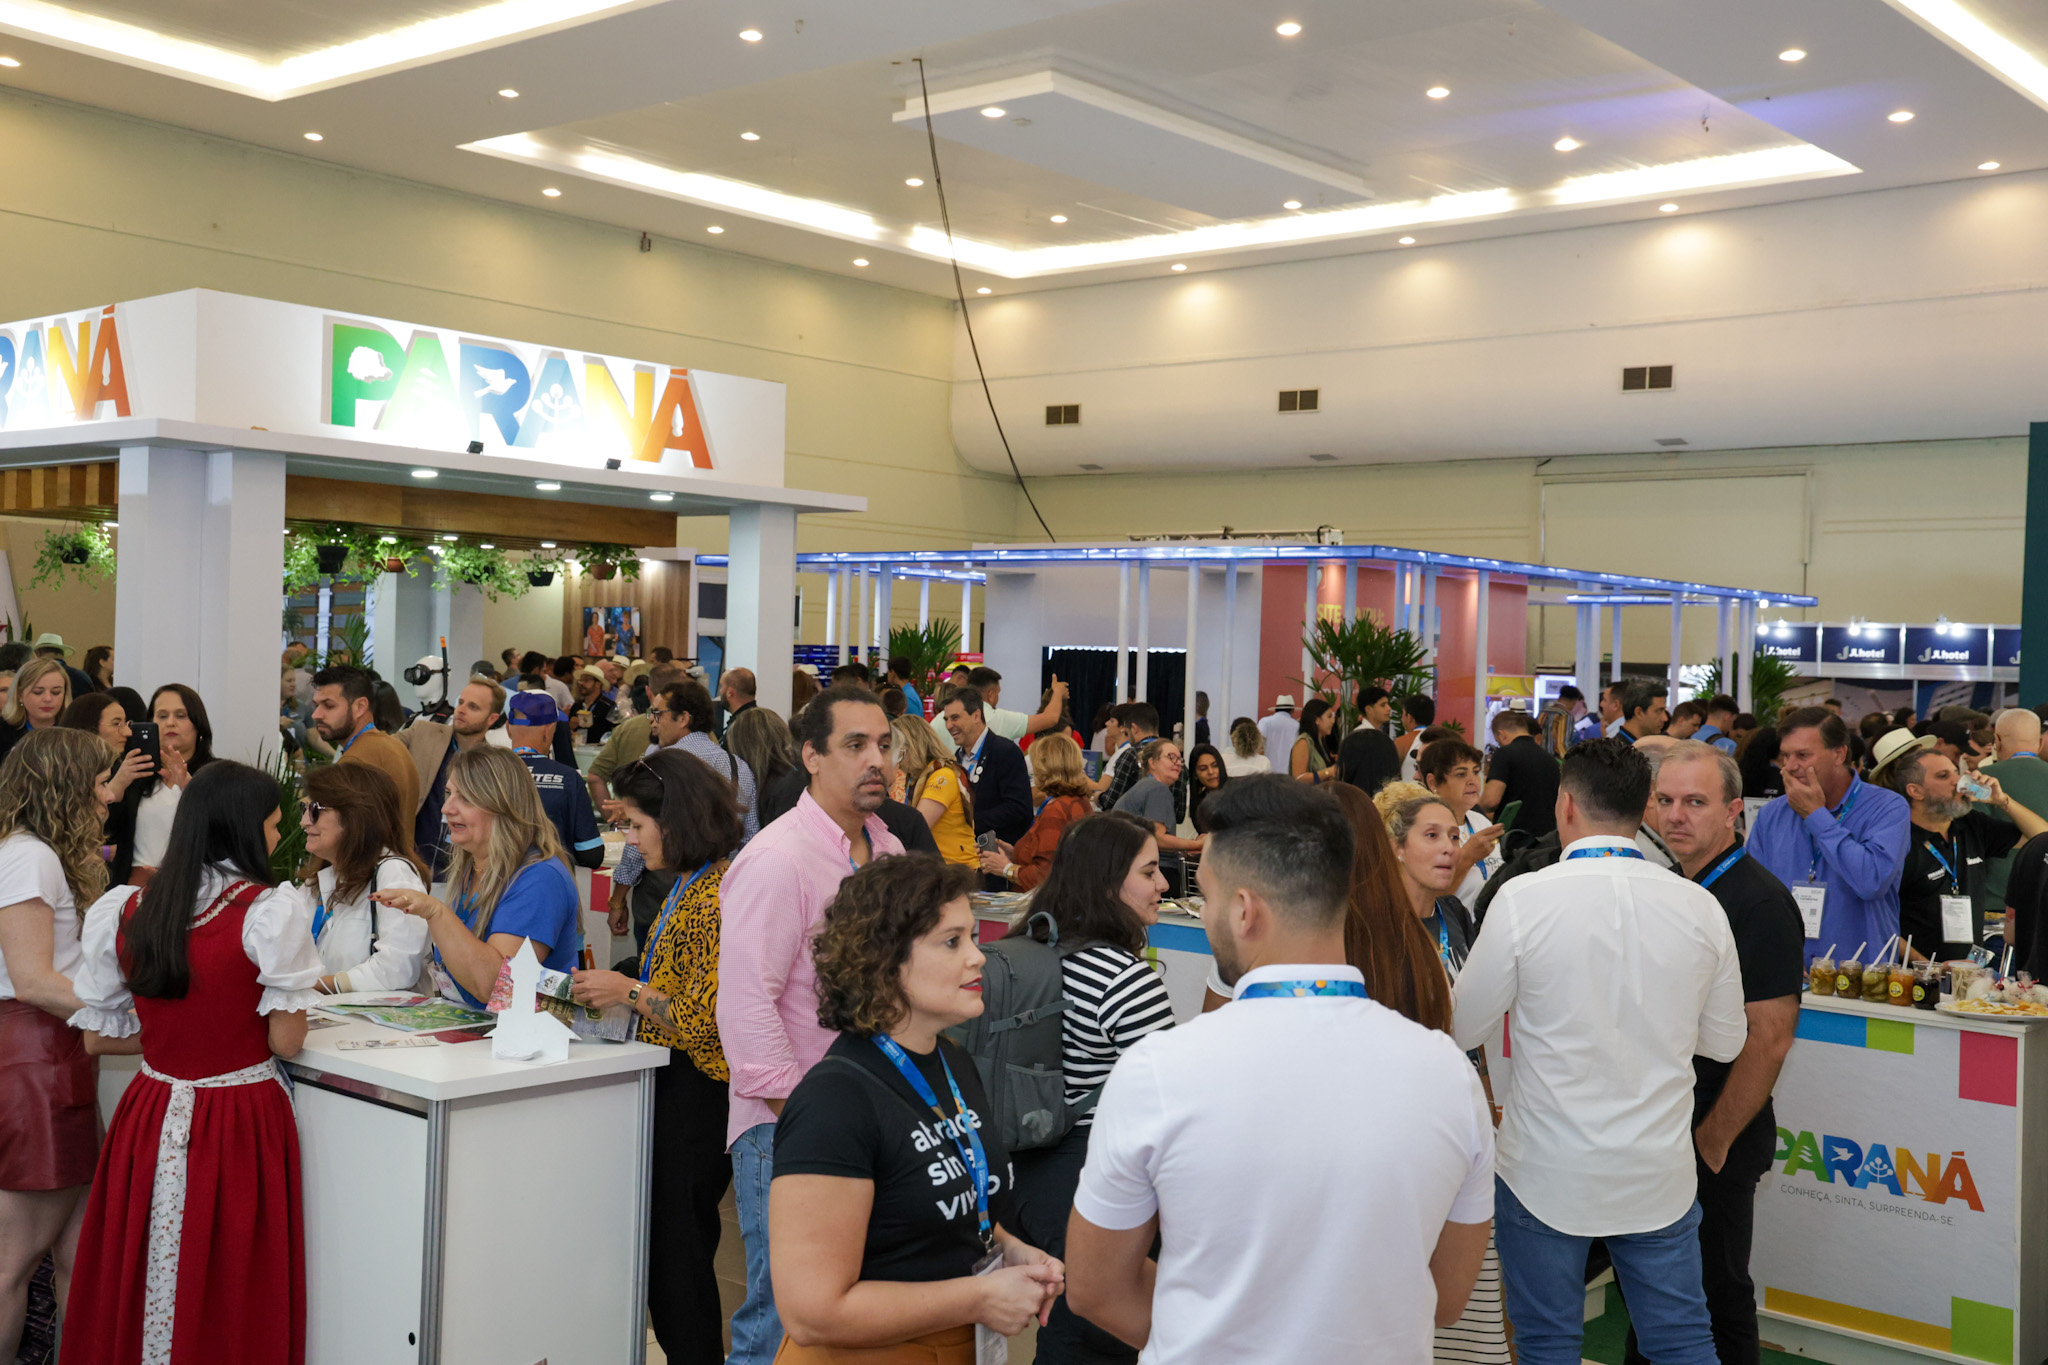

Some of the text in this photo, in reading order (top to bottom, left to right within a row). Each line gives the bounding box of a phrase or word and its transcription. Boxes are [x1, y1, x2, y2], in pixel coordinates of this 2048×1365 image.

[331, 321, 714, 470] PARANÁ
[1780, 1183, 1956, 1227] CONHEÇA, SINTA, SURPREENDA-SE.
